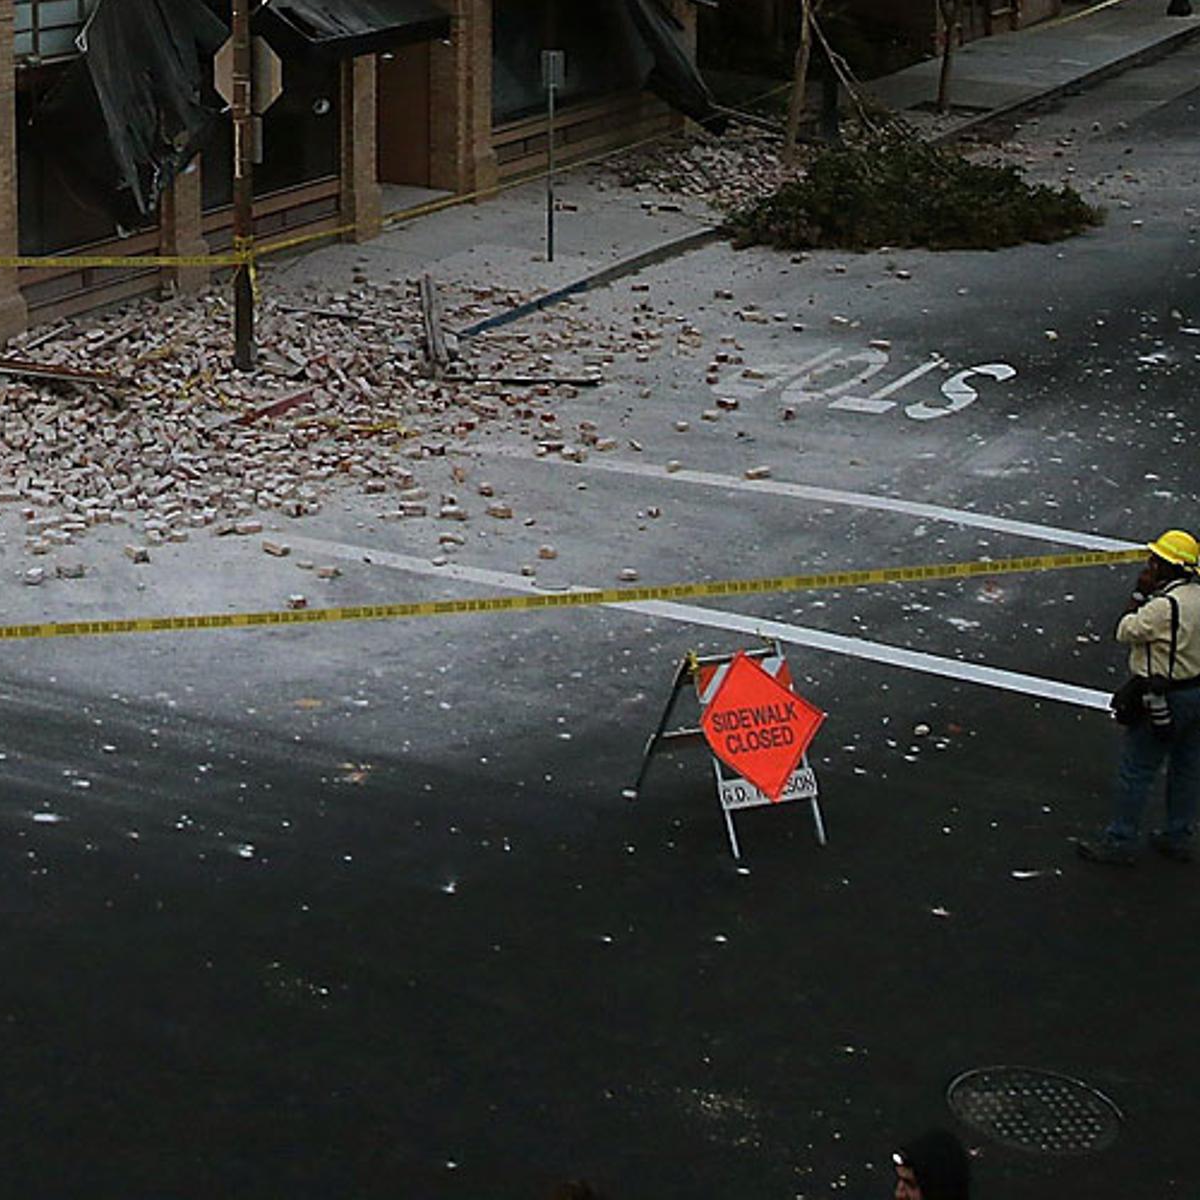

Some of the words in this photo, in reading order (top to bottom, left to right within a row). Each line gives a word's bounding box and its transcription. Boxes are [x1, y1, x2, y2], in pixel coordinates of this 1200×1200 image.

[710, 347, 1017, 421] STOP
[711, 701, 798, 733] SIDEWALK
[725, 726, 794, 755] CLOSED
